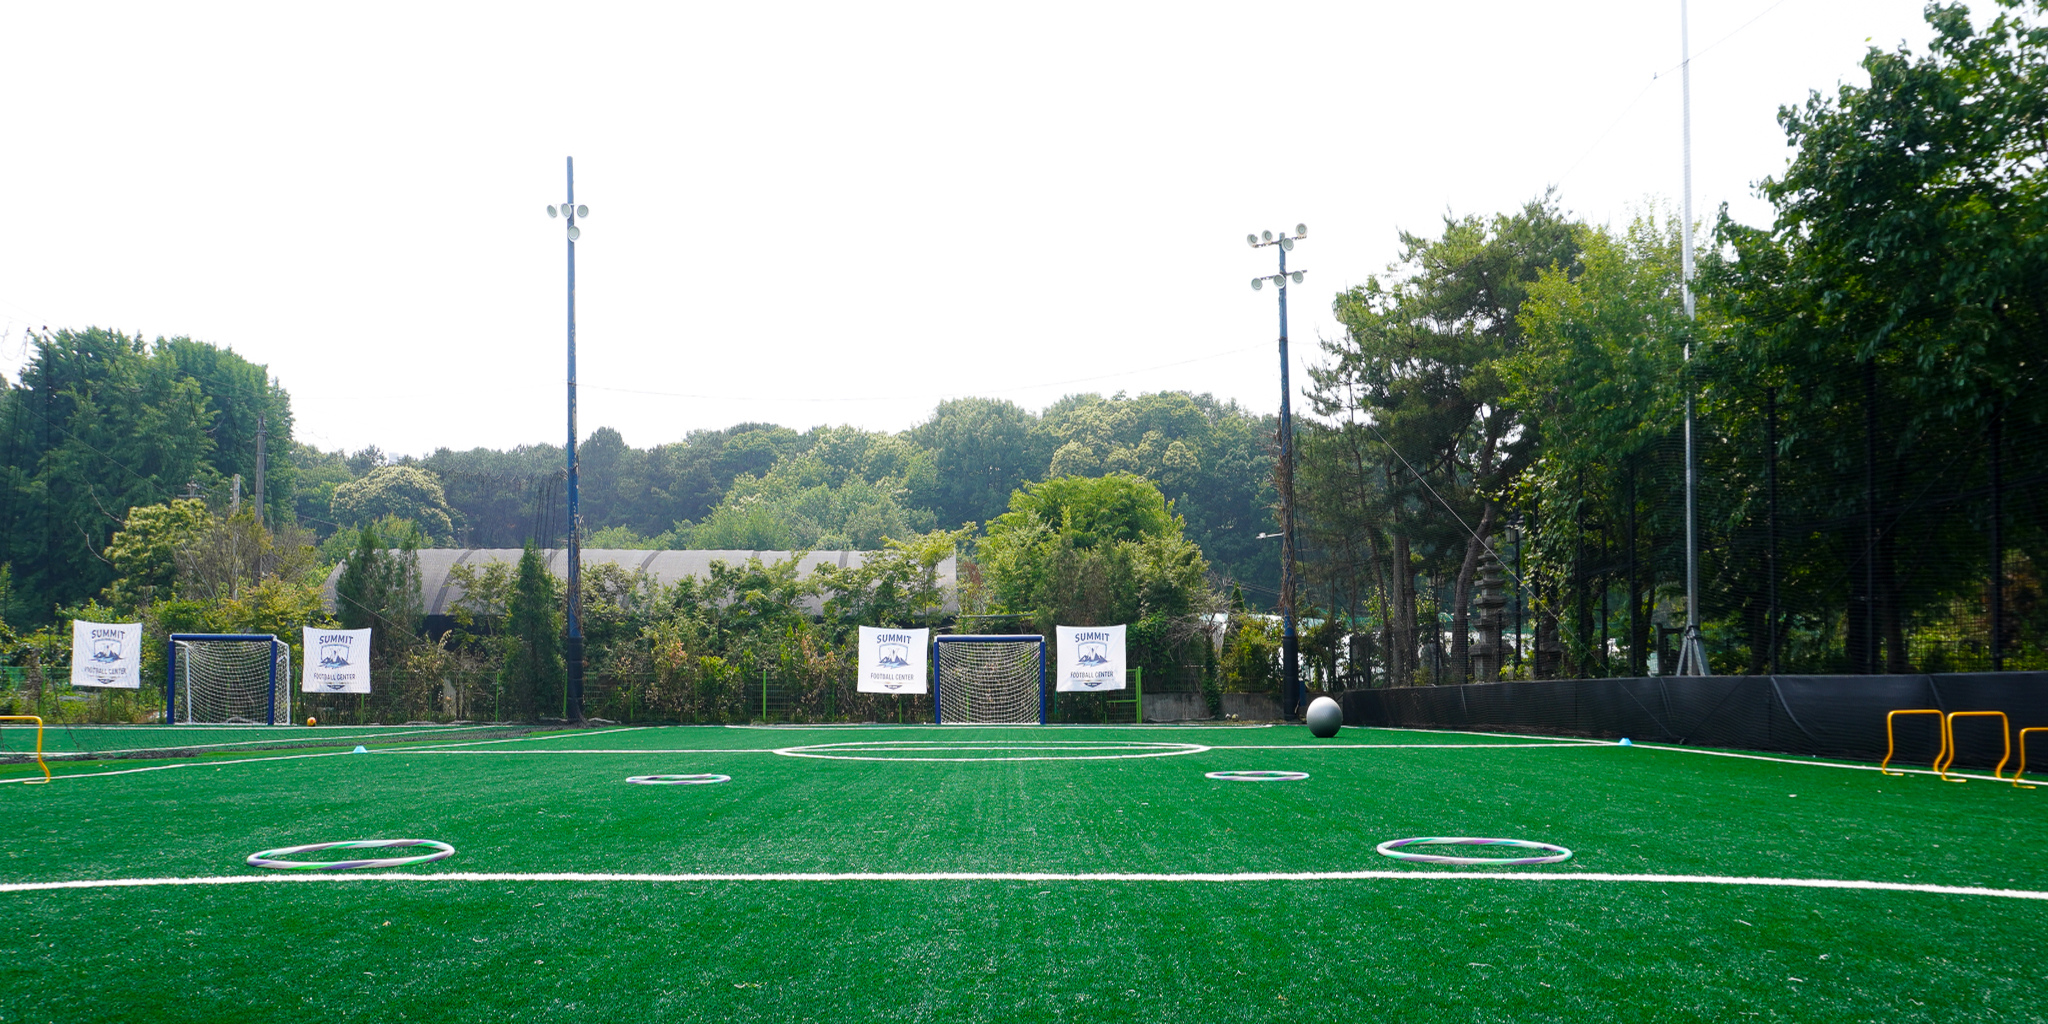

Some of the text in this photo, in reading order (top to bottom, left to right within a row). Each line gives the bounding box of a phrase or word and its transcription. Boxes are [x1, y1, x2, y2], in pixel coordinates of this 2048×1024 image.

[91, 629, 126, 640] SUMMIT
[319, 634, 354, 645] SUMMIT
[876, 634, 912, 645] SUMMIT
[1075, 632, 1110, 643] SUMMIT
[313, 672, 356, 681] FOOTBALL CENTER
[870, 672, 914, 681] FOOTBALL CENTER
[1070, 670, 1114, 679] FOOTBALL CENTER
